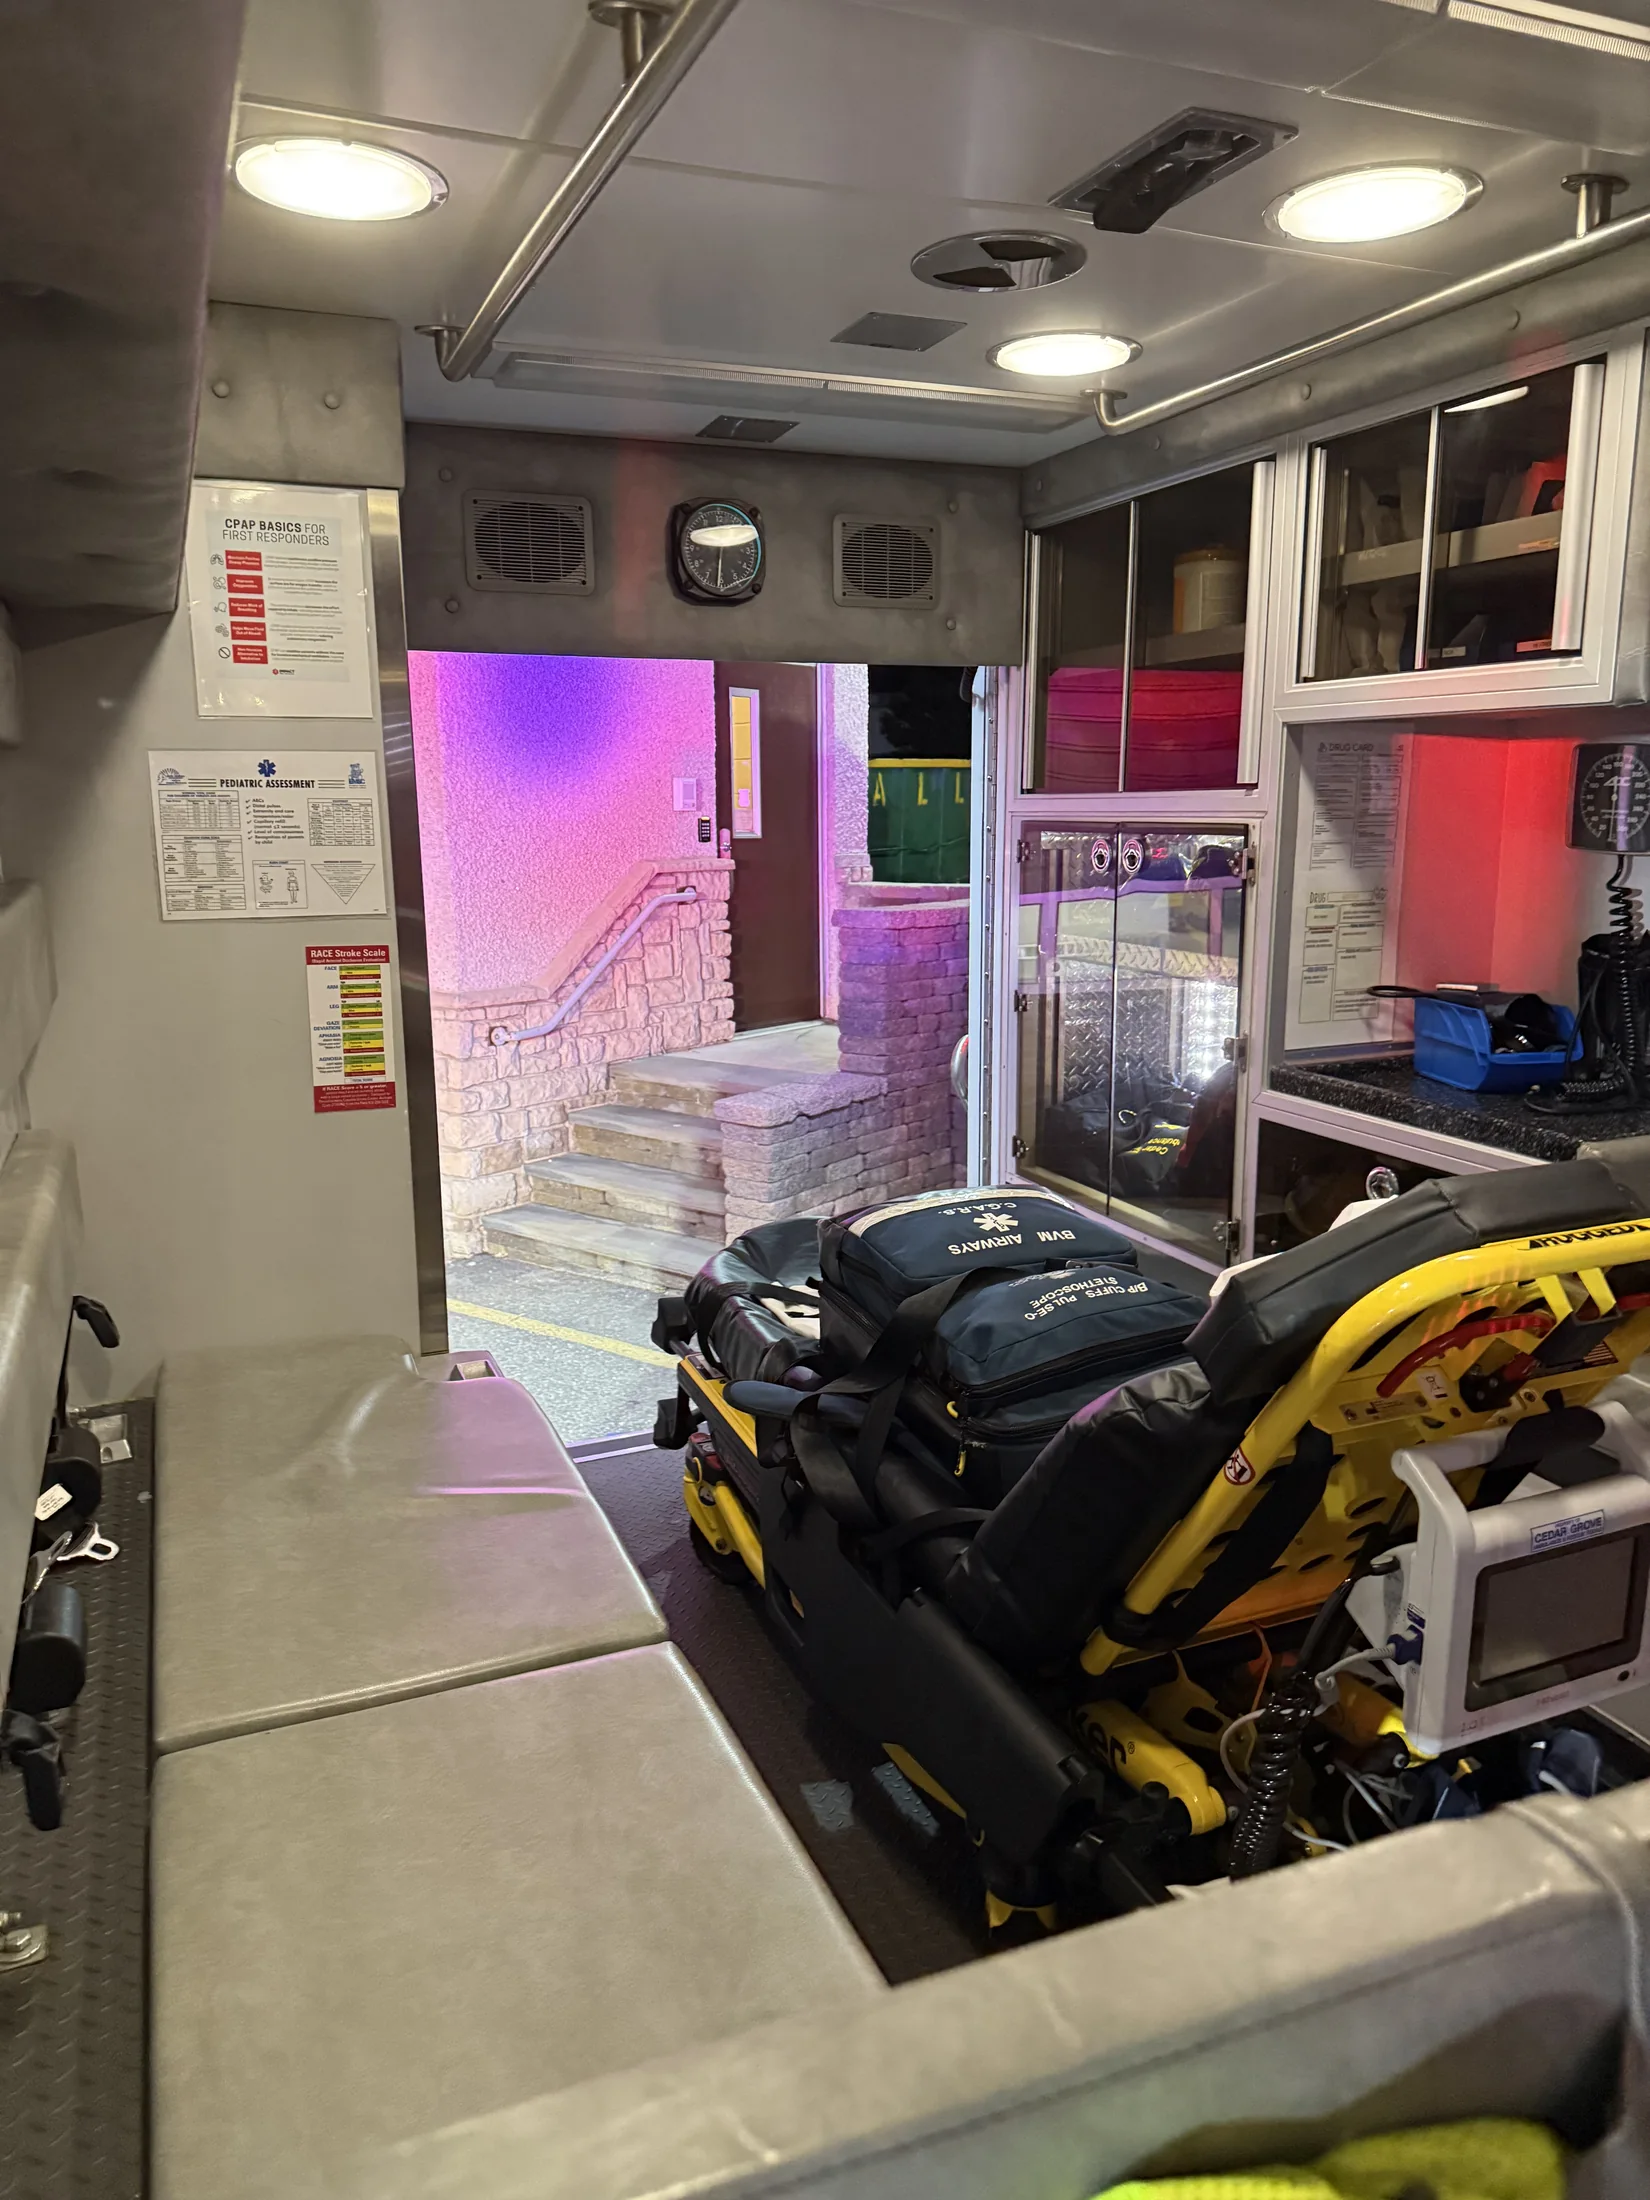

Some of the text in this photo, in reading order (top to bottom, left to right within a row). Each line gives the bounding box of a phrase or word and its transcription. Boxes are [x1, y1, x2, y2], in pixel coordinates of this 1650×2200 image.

[225, 519, 325, 534] CPAP BASICS FOR
[223, 530, 329, 545] FIRST RESPONDERS
[220, 779, 315, 788] PEDIATRIC ASSESSMENT
[335, 949, 361, 957] Stroke
[948, 1230, 1076, 1255] BVM AIRWAYS
[1085, 1285, 1125, 1298] CUFFS
[1534, 1527, 1566, 1543] CEDAR
[1570, 1517, 1602, 1533] GROVE
